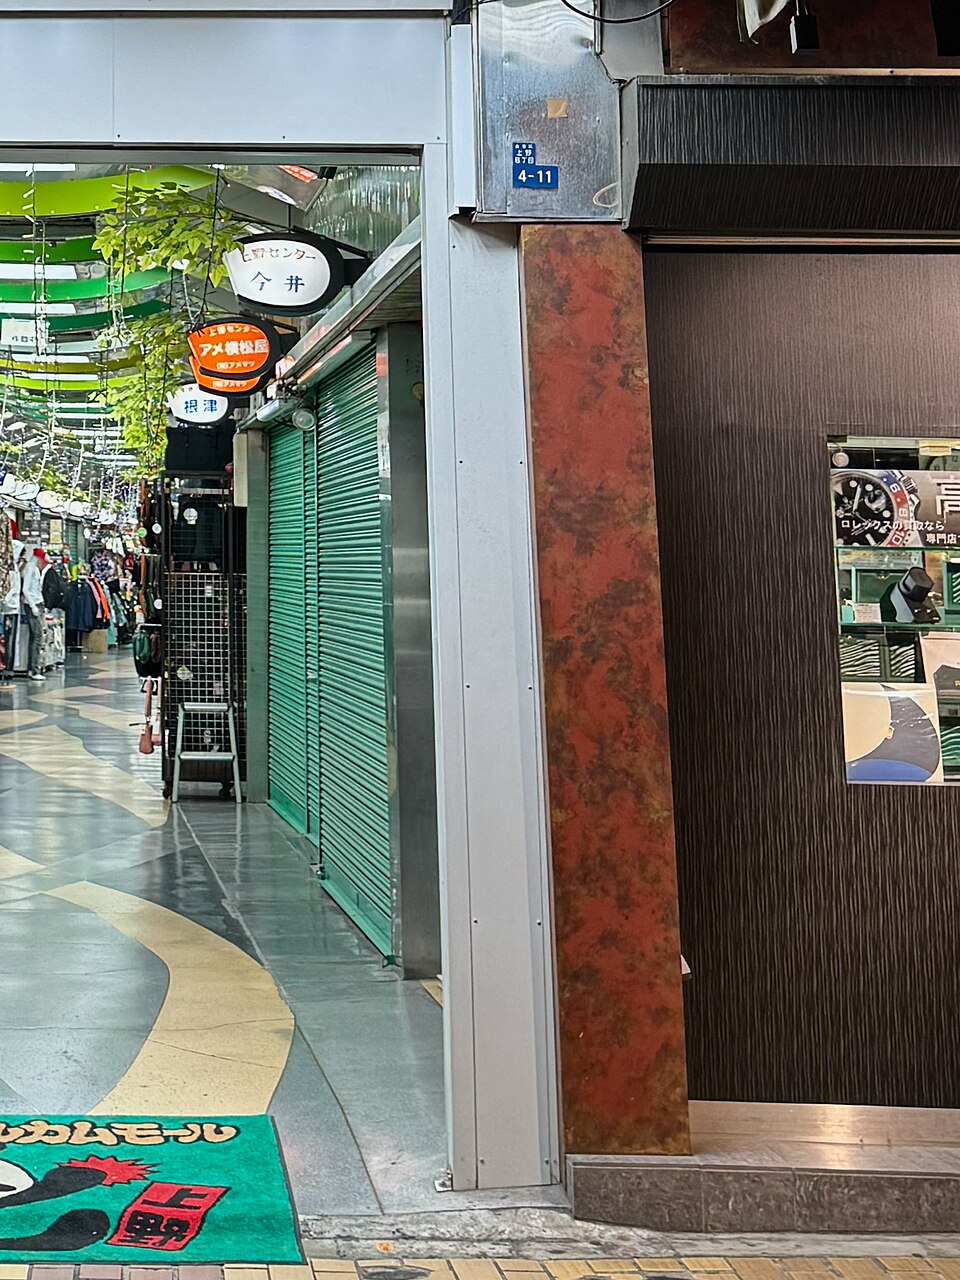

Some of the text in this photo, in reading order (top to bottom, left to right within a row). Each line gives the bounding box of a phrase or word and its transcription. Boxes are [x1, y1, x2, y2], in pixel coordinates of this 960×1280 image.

[517, 169, 551, 184] 4-11
[242, 247, 316, 262] 上野センター
[250, 271, 306, 293] 今井
[209, 325, 260, 337] 上野センター
[199, 339, 268, 357] アメ横松屋
[184, 399, 218, 414] 根津
[841, 520, 945, 531] ロレックスの買取なら
[926, 533, 960, 545] 専門店
[117, 1187, 211, 1248] 上野
